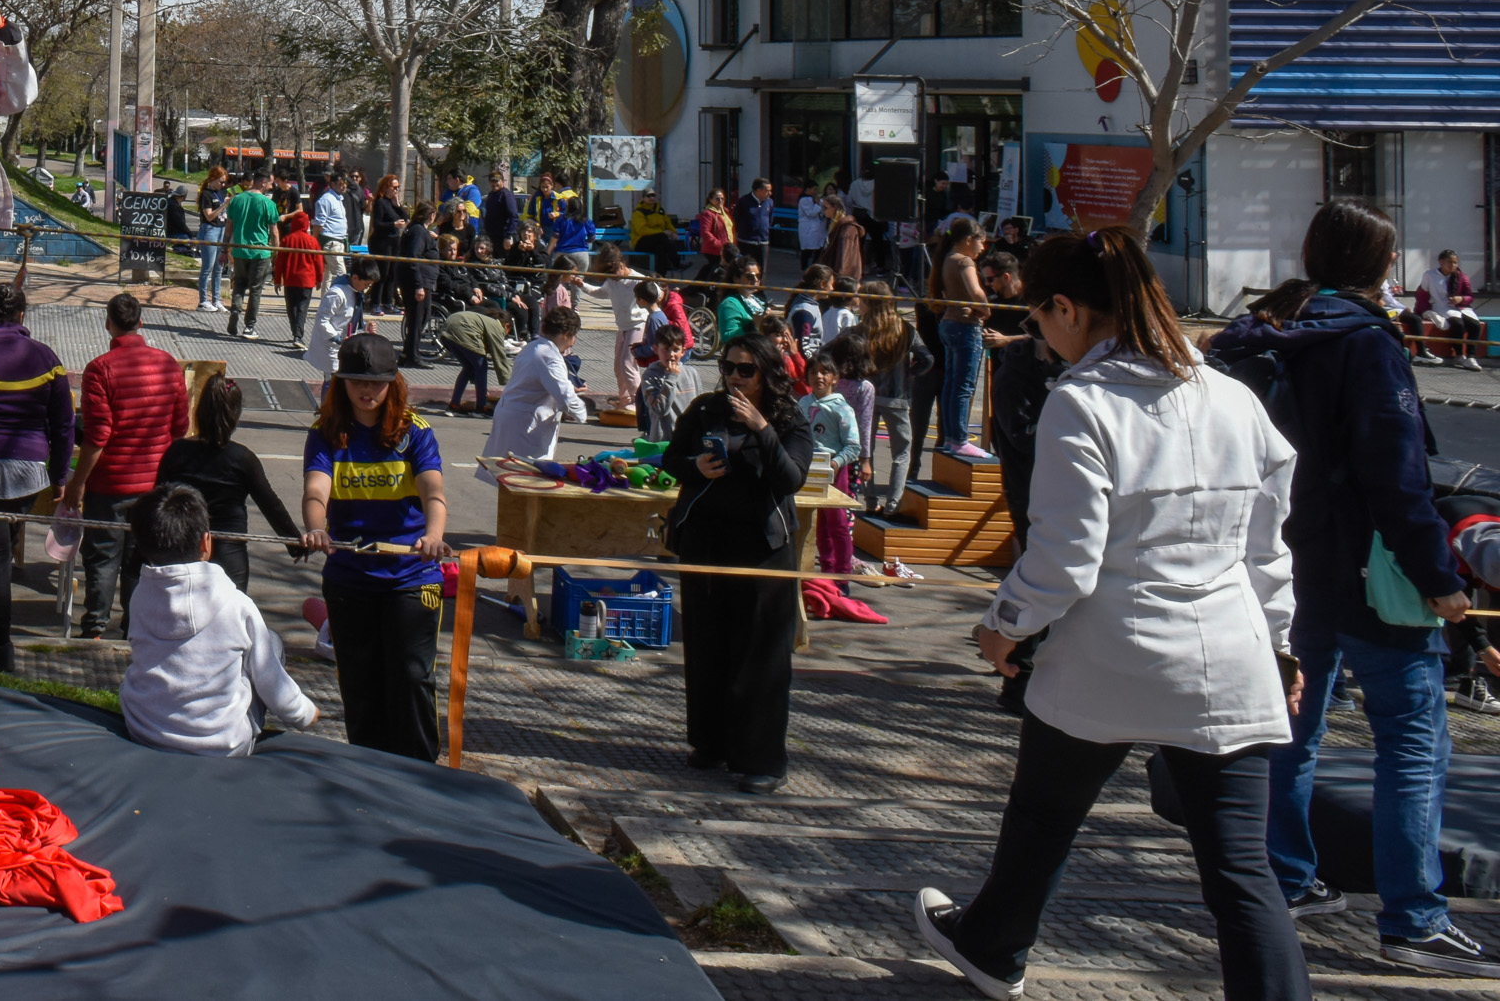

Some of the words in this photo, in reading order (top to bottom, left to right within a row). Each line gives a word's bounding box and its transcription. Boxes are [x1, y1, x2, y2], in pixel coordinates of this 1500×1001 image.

[879, 106, 914, 114] Monterroso
[123, 196, 168, 211] CENSO
[131, 211, 165, 228] 2023
[121, 225, 167, 238] ENTREVISTA
[129, 249, 140, 261] 10
[146, 251, 156, 263] 16
[340, 472, 405, 489] betsson
